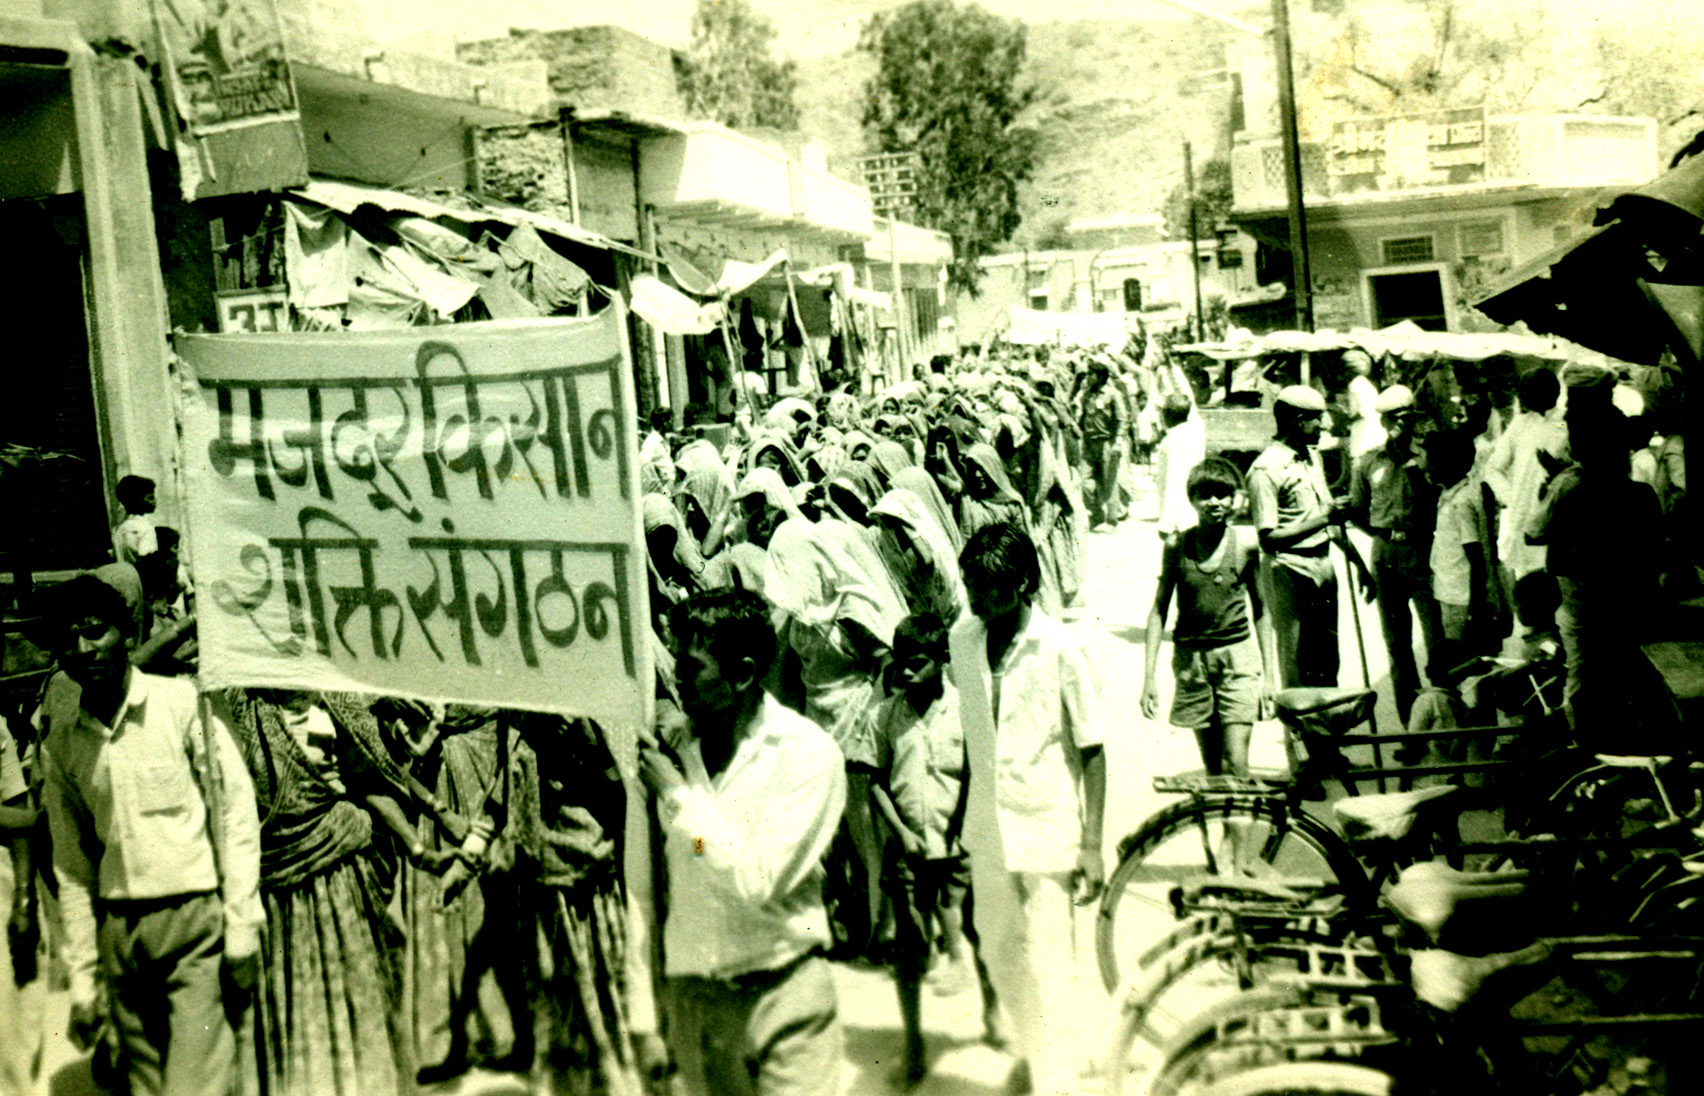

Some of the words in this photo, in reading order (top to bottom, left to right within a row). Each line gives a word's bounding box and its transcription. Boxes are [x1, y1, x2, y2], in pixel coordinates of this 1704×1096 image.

[199, 375, 423, 523] मजदूर
[414, 341, 632, 501] किसान
[211, 506, 403, 660] शक्ति
[406, 517, 637, 679] संगठन
